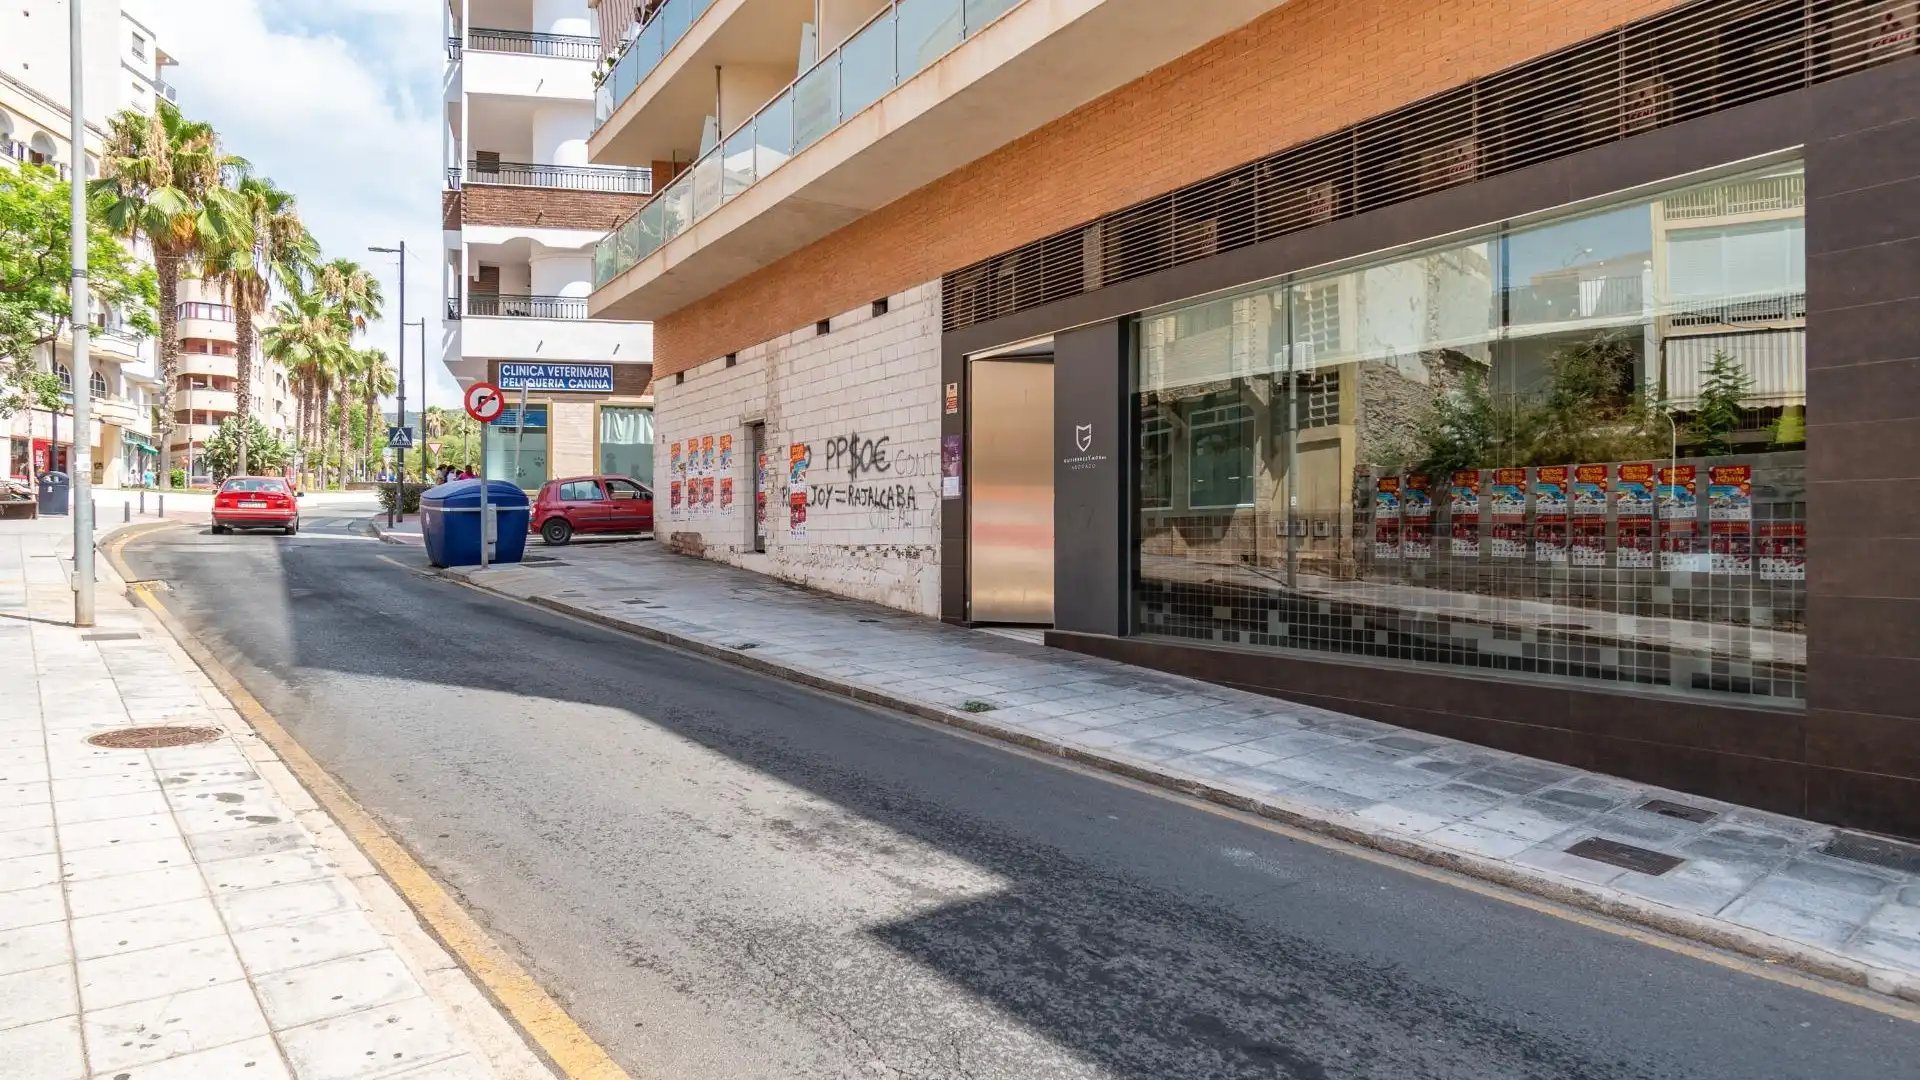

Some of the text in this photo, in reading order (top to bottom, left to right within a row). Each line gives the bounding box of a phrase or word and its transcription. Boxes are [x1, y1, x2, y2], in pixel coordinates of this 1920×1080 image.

[502, 365, 609, 378] CLINICA VETERINARIA
[503, 377, 609, 389] PELUQUERIA CANINA
